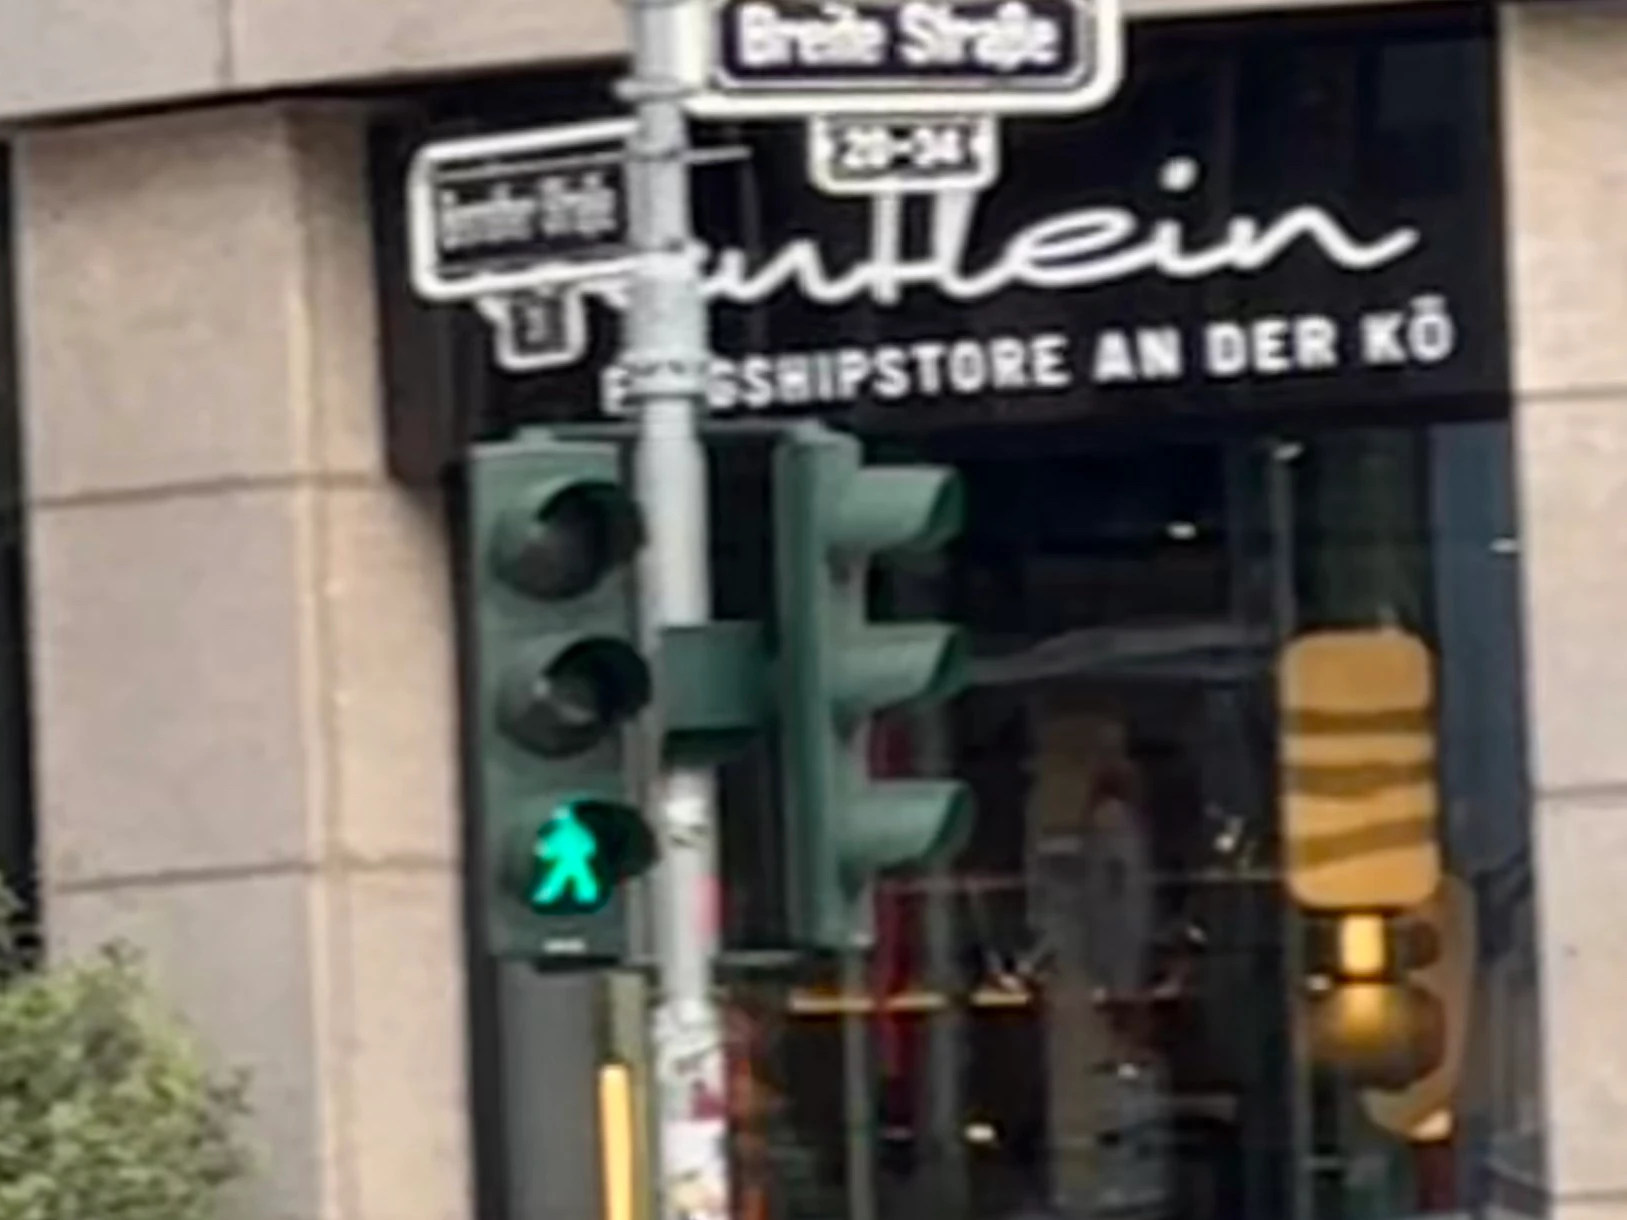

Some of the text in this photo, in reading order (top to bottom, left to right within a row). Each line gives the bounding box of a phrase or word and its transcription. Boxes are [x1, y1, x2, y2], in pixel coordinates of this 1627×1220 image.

[1091, 324, 1180, 383] AN
[1206, 315, 1338, 376] DER
[1361, 294, 1455, 363] KÖ
